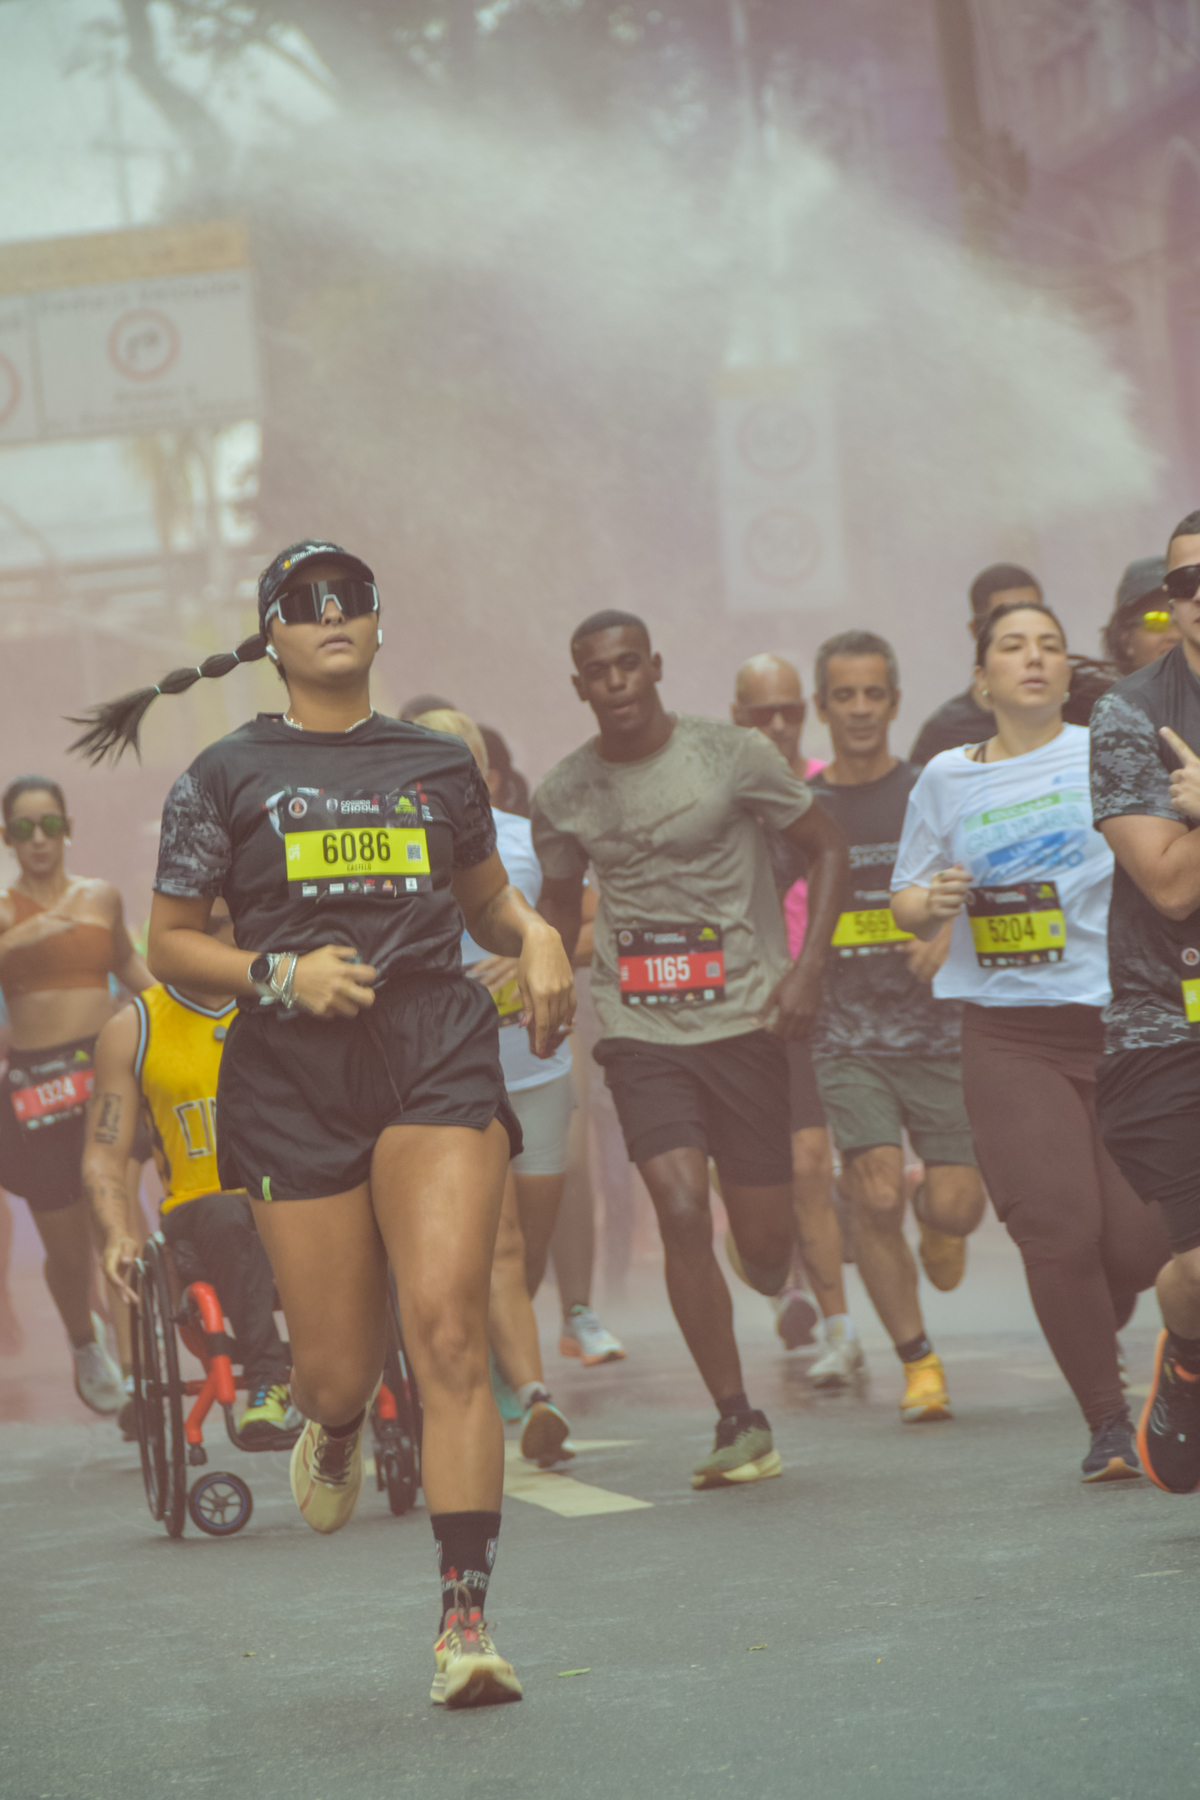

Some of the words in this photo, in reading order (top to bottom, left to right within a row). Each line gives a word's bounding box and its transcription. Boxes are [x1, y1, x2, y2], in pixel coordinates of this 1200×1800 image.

[322, 831, 391, 864] 6086
[346, 863, 372, 872] CASTELO
[987, 916, 1036, 943] 5204
[644, 956, 690, 983] 1165
[35, 1077, 76, 1106] 1324
